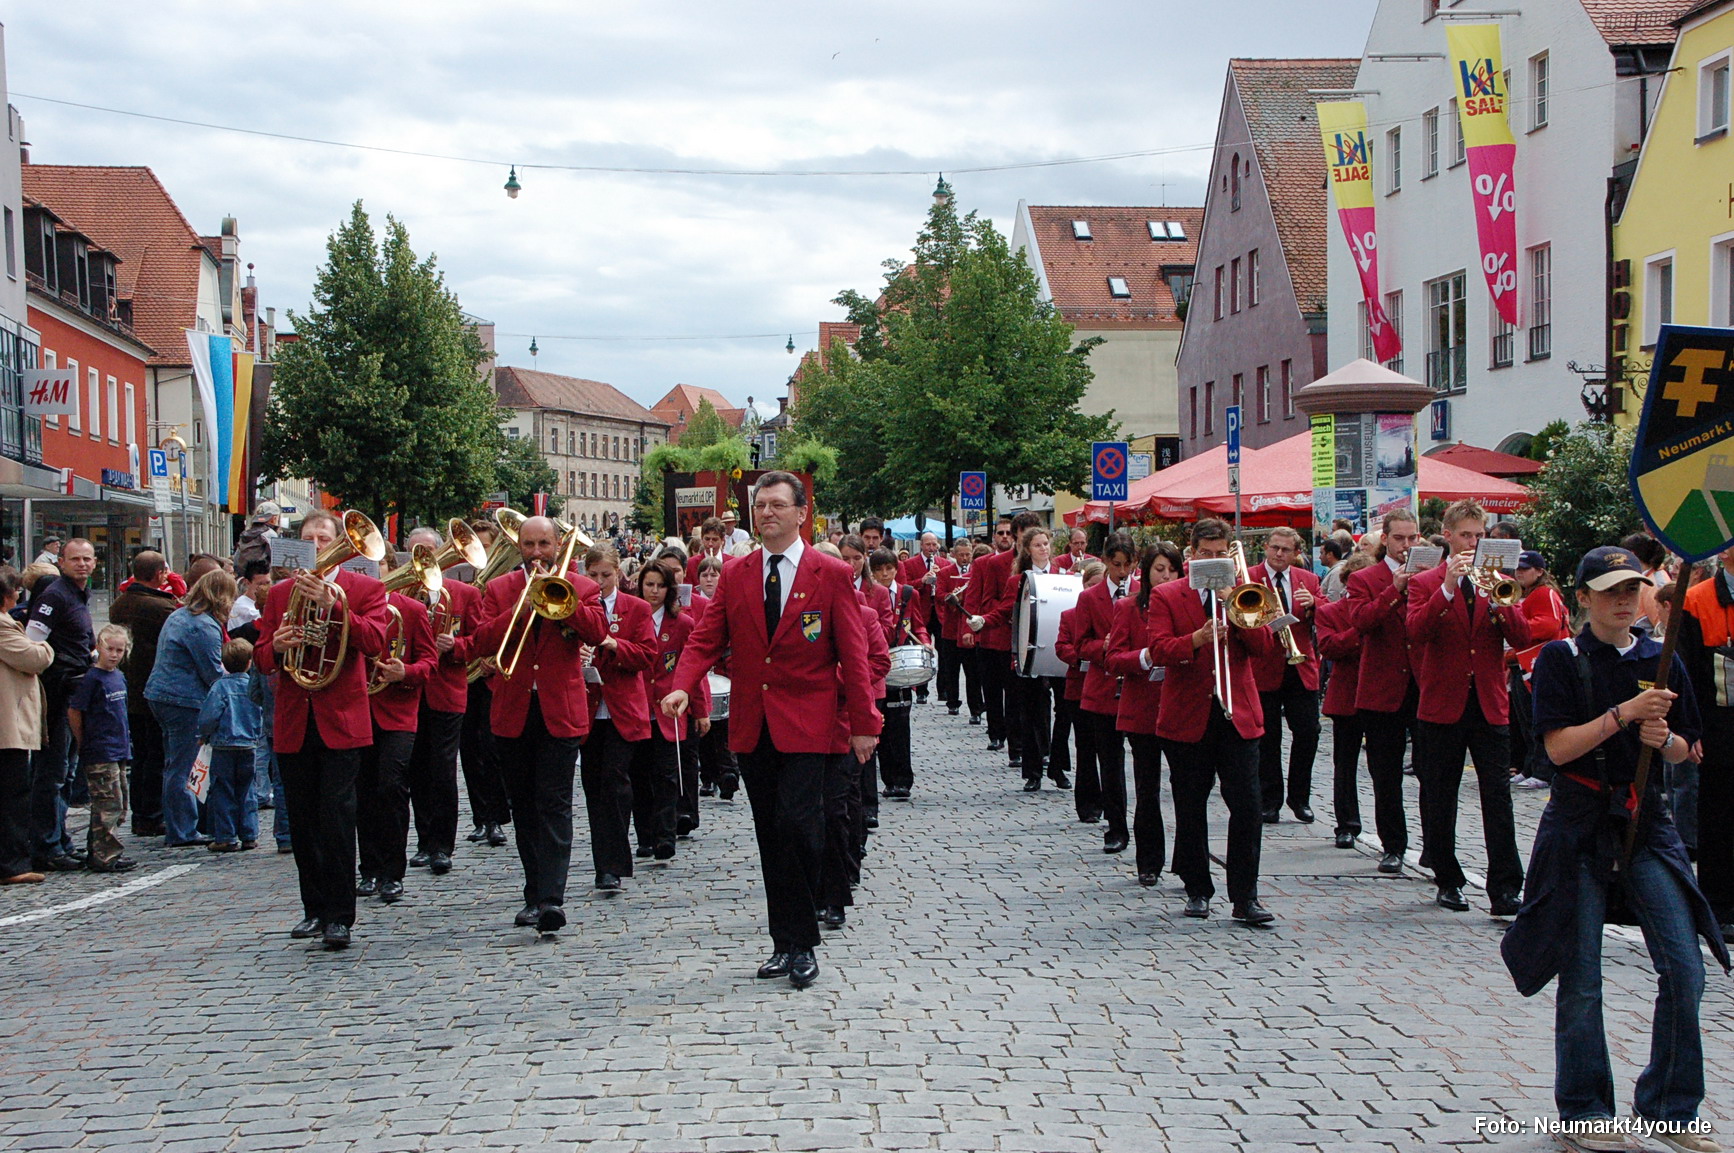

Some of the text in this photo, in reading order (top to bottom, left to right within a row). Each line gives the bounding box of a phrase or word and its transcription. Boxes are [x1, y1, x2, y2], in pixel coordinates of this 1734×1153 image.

[1612, 259, 1631, 414] HOTEL
[29, 379, 70, 405] H&M
[1228, 412, 1237, 445] P
[1658, 420, 1732, 460] Neumarkt
[153, 453, 163, 473] P
[1364, 422, 1374, 486] STADTMUSEUM
[675, 491, 698, 503] Neumarkt
[1096, 484, 1125, 497] TAXI
[963, 498, 983, 507] TAXI
[39, 603, 53, 616] 28
